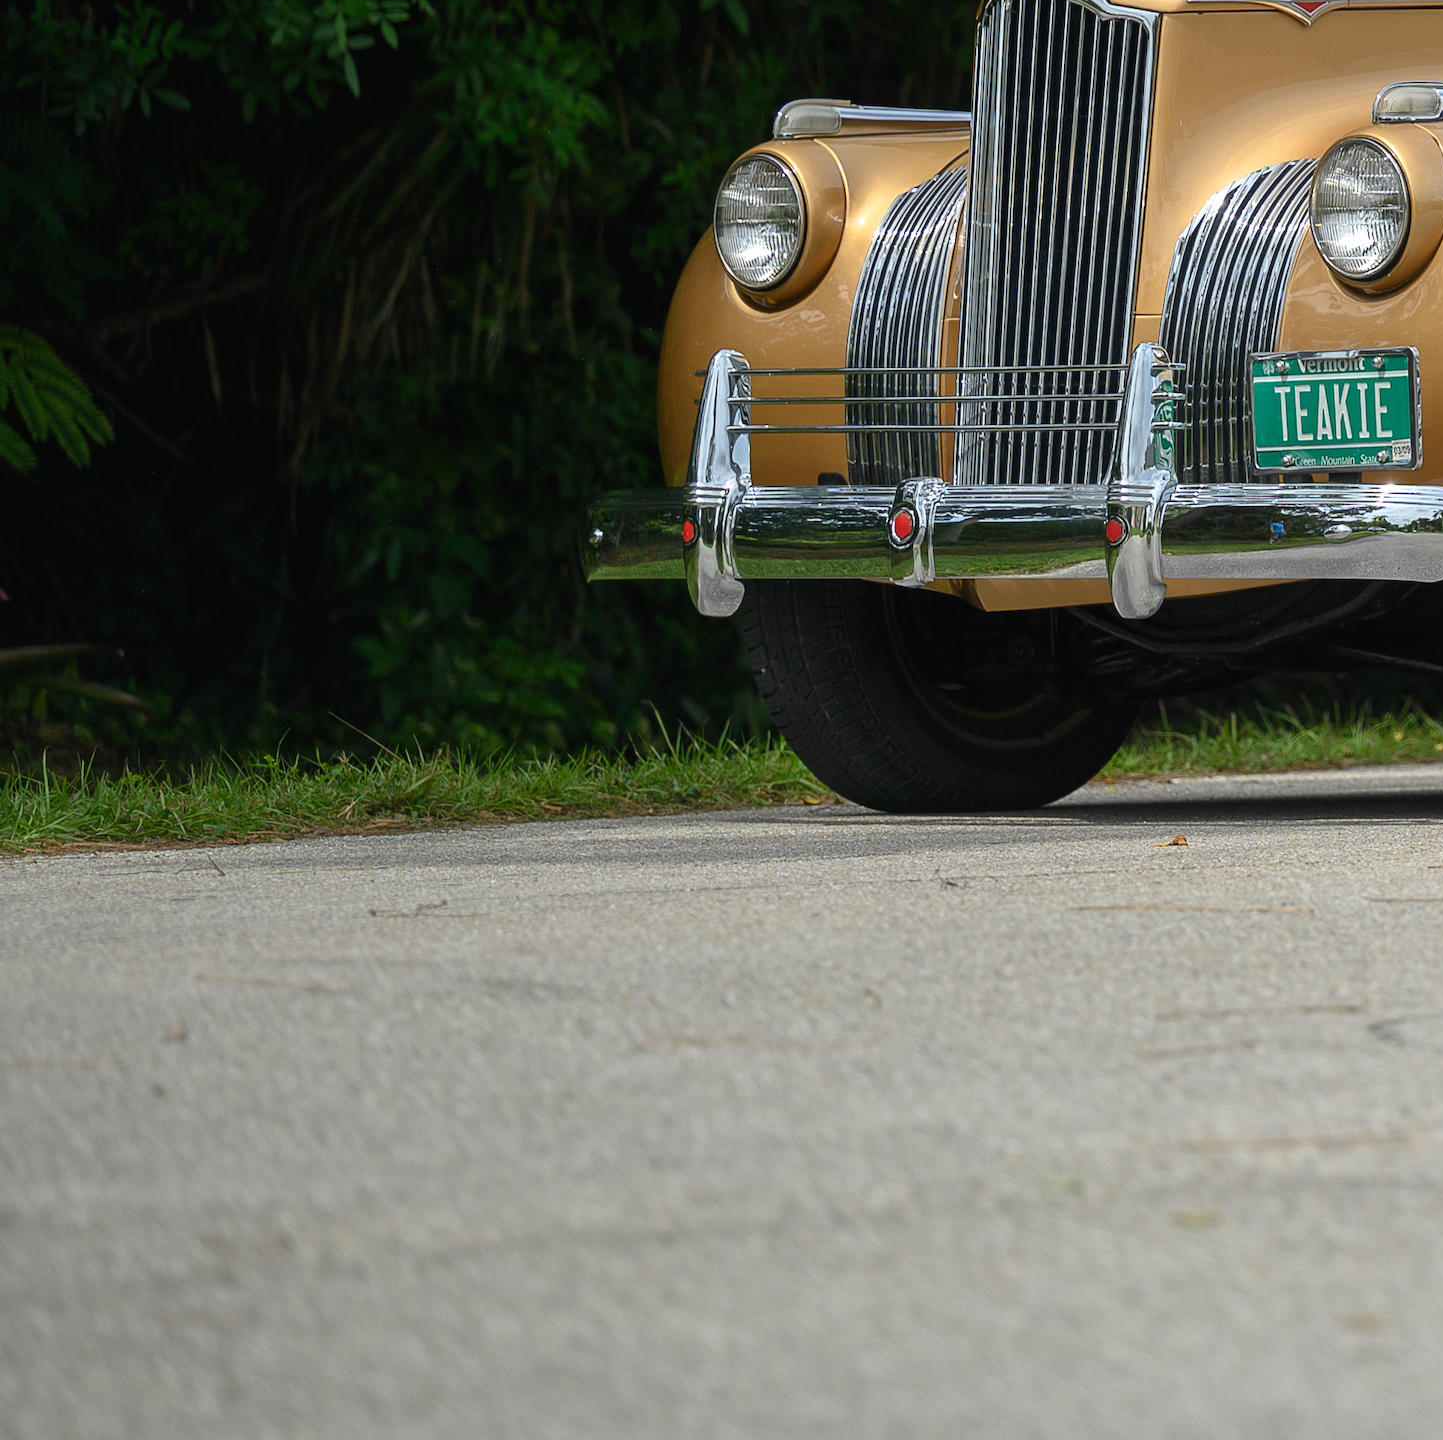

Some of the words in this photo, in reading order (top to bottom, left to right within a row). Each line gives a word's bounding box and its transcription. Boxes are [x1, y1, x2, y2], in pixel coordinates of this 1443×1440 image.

[1297, 357, 1366, 373] Vermont
[1274, 381, 1393, 441] TEAKIE
[1295, 456, 1316, 466] Green
[1321, 455, 1355, 465] Mountain
